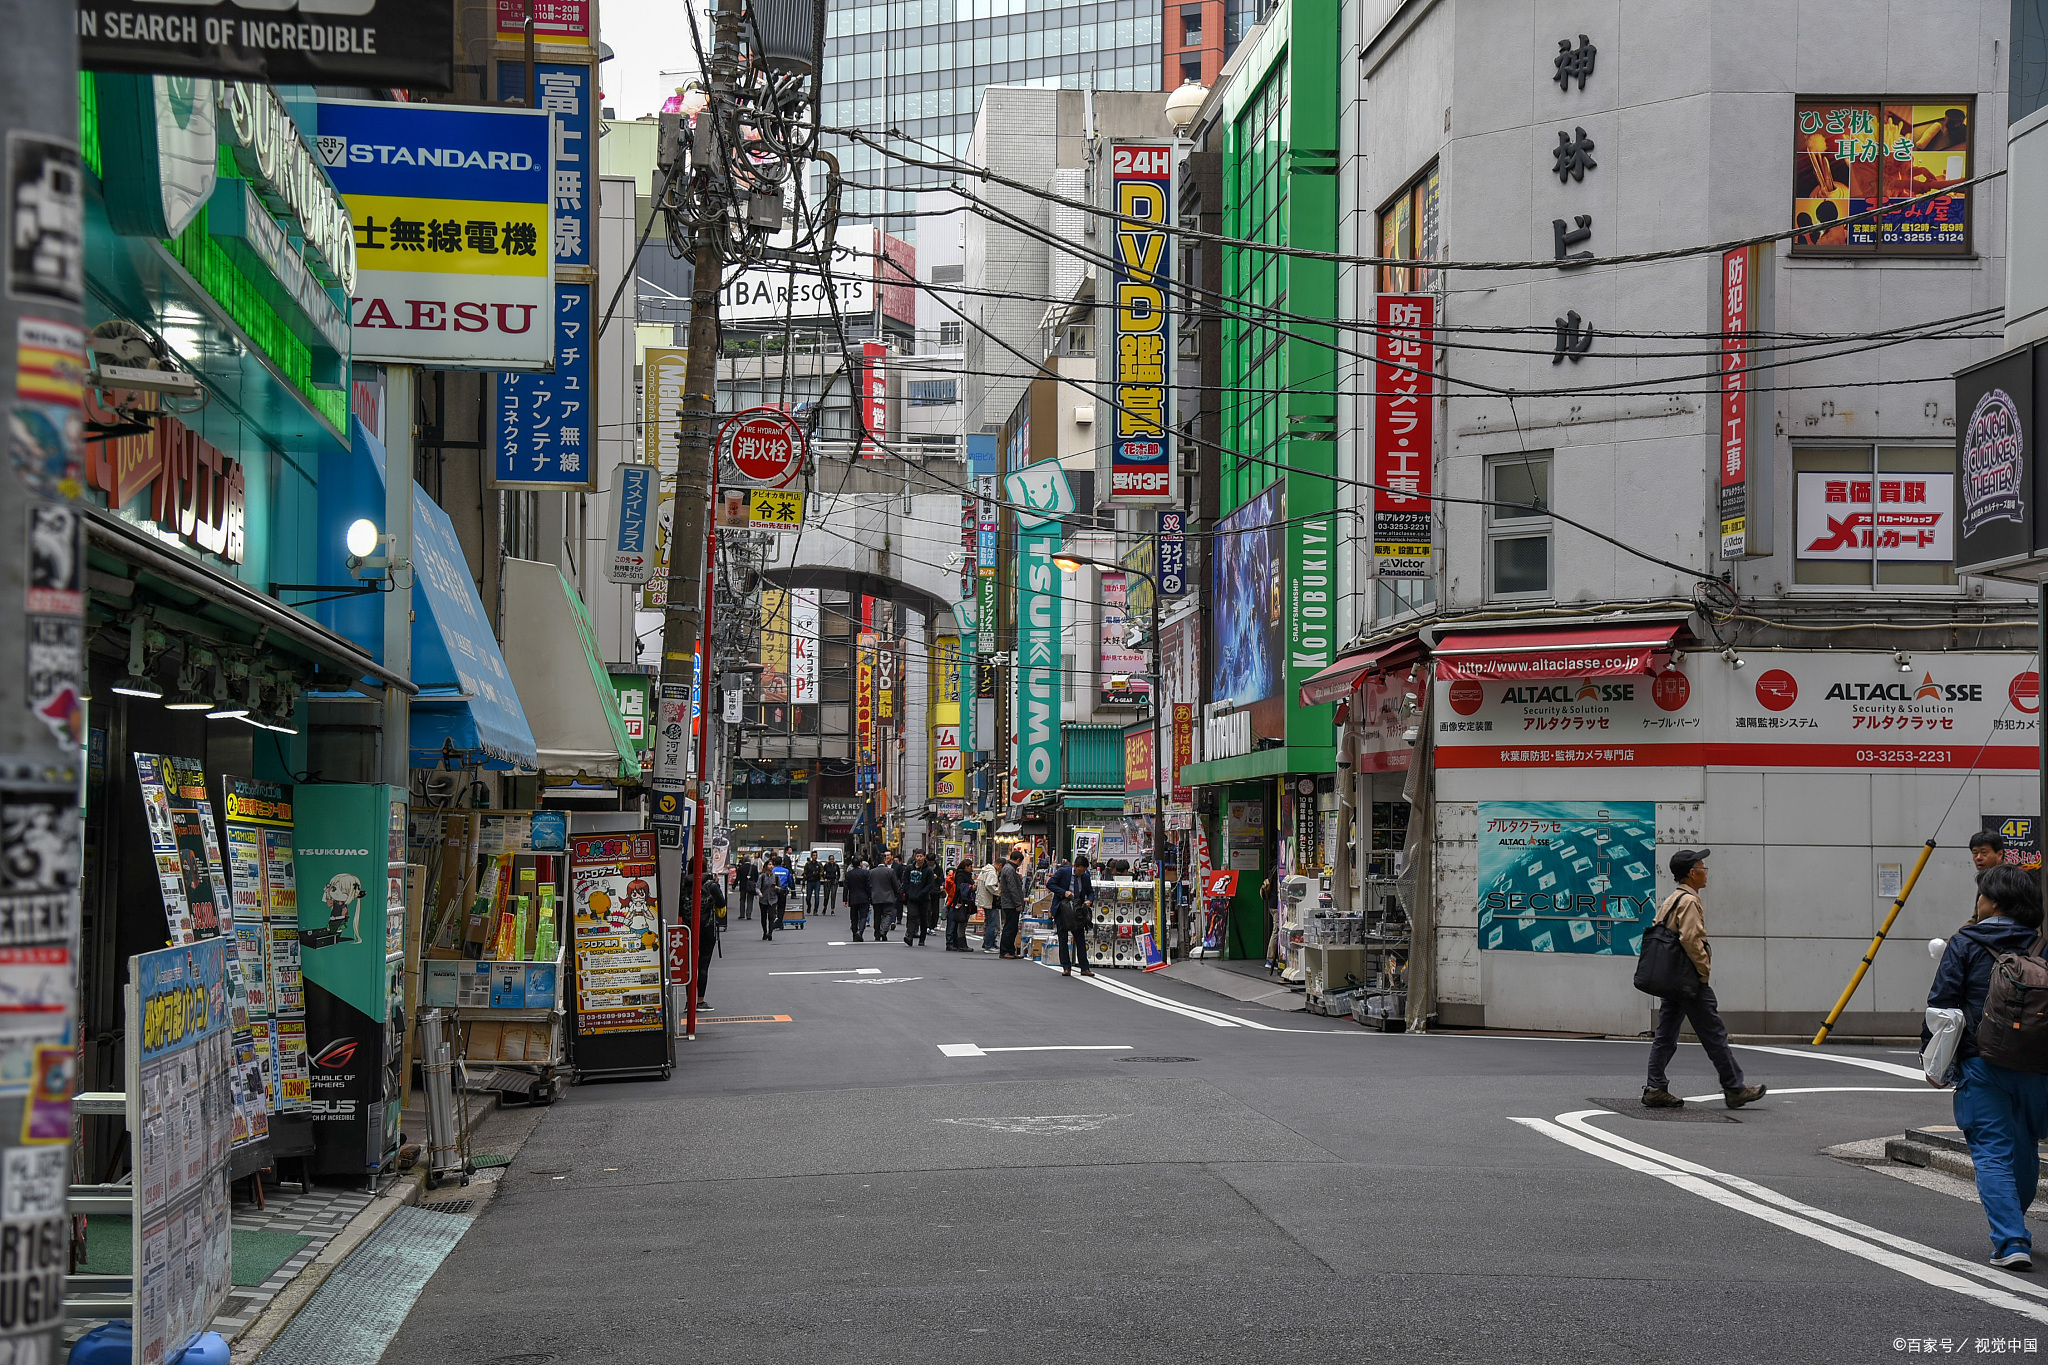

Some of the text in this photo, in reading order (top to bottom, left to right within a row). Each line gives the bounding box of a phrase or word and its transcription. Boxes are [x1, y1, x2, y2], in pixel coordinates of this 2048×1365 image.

[104, 11, 198, 43] SEARCH
[205, 17, 235, 46] OF
[241, 20, 377, 54] INCREDIBLE
[1799, 109, 1875, 134] ひざ枕
[349, 144, 533, 171] STANDARD
[1835, 138, 1915, 162] 耳かき
[1114, 149, 1169, 174] 24H
[1552, 34, 1597, 364] 神林ビル
[777, 282, 863, 302] RESORTS
[1117, 181, 1165, 437] DVD鑑賞
[1727, 255, 1743, 476] 防犯カメラ・工事
[560, 294, 580, 472] アマチュア無線
[1386, 303, 1422, 504] 防犯カメラ・工事
[743, 426, 784, 435] FIRE HYDRANT
[1976, 410, 2008, 445] AKIBA
[737, 436, 788, 462] 消火栓
[1969, 437, 2017, 473] CULTURES
[1113, 472, 1168, 490] 受付3F
[1971, 465, 2013, 499] THEATER
[752, 491, 801, 500] タピオカ専門店
[1825, 480, 1926, 503] 高価買取
[626, 469, 644, 551] コスメイトプラス
[1378, 523, 1428, 531] 03-3253-2231
[1162, 544, 1172, 573] カフェ
[1173, 543, 1183, 574] メイド
[1391, 559, 1425, 568] Victor
[613, 572, 644, 580] 3526-5013
[614, 565, 644, 573] 秋月電子5F
[1379, 568, 1425, 577] Panasonic
[1166, 578, 1178, 590] 2F
[1293, 520, 1327, 668] KOTOBUKIYA
[985, 577, 994, 632] メロンブックス
[1028, 537, 1051, 784] TSUKUMO
[1457, 655, 1639, 674] http://www.altaclasse.co.jp
[878, 650, 893, 718] DVD買取
[981, 665, 992, 692] ラーメン
[1523, 706, 1560, 715] Security
[1570, 705, 1609, 714] Solution
[1853, 704, 1896, 714] Security
[1908, 704, 1954, 713] Solution
[1440, 720, 1493, 732] 画像安定装置
[1523, 717, 1610, 731] アルタクラッセ
[1643, 717, 1700, 729] ケーブル・パーツ
[1736, 717, 1818, 729] 遠隔監視システム
[1852, 716, 1954, 730] アルタクラッセ
[1500, 749, 1635, 762] 秋葉原防犯・監視カメラ専門店
[1856, 750, 1952, 762] 03-3253-2231
[1487, 820, 1561, 833] アルタクラッセ
[2000, 820, 2030, 838] 4F
[576, 867, 621, 879] レトロゲーム
[285, 1080, 305, 1097] 13980
